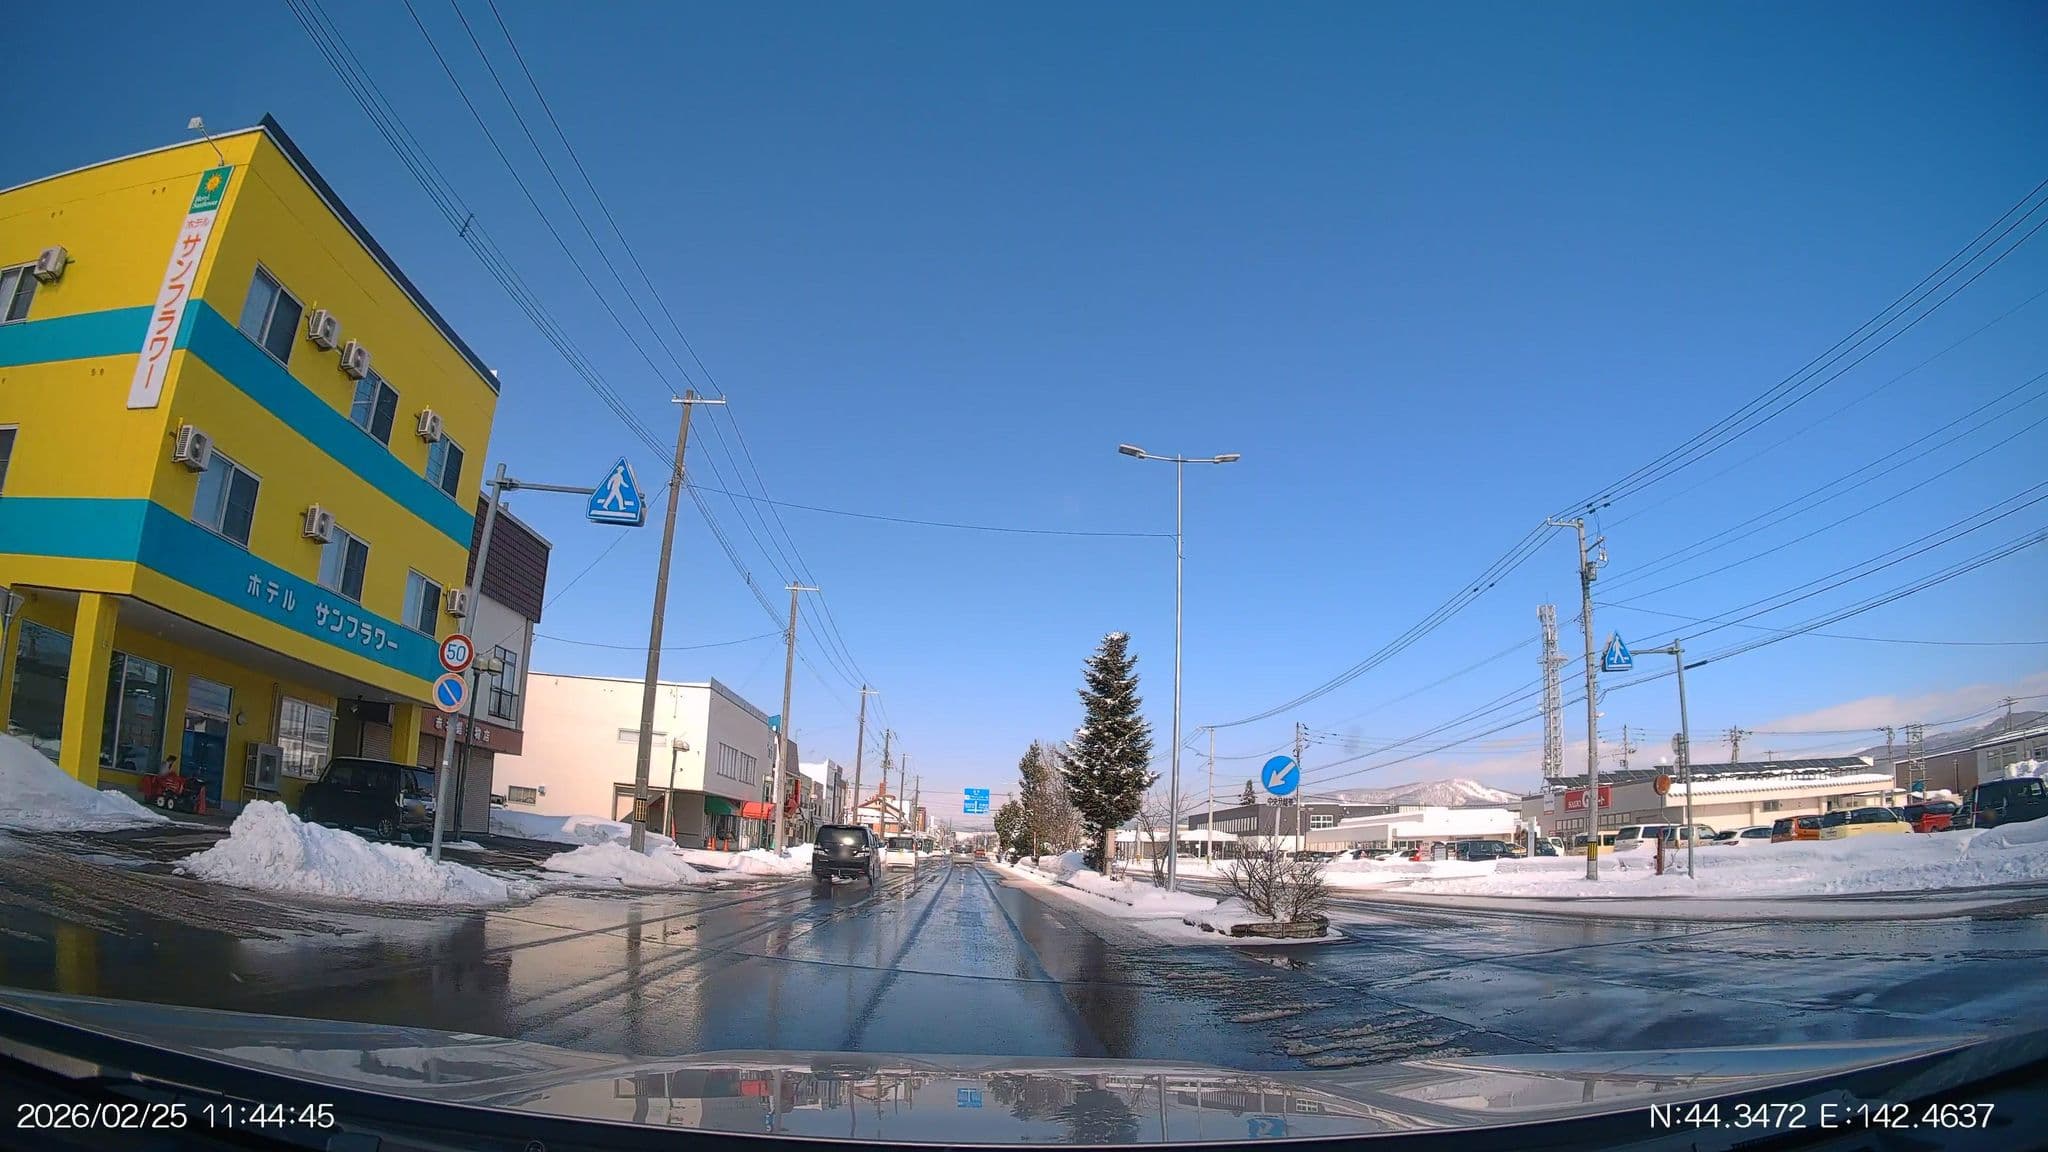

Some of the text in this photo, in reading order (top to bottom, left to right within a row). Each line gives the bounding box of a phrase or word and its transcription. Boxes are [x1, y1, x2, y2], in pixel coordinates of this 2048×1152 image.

[144, 234, 202, 390] サンフラワー
[247, 574, 399, 650] ホテル サンフラワー
[446, 643, 467, 662] 50
